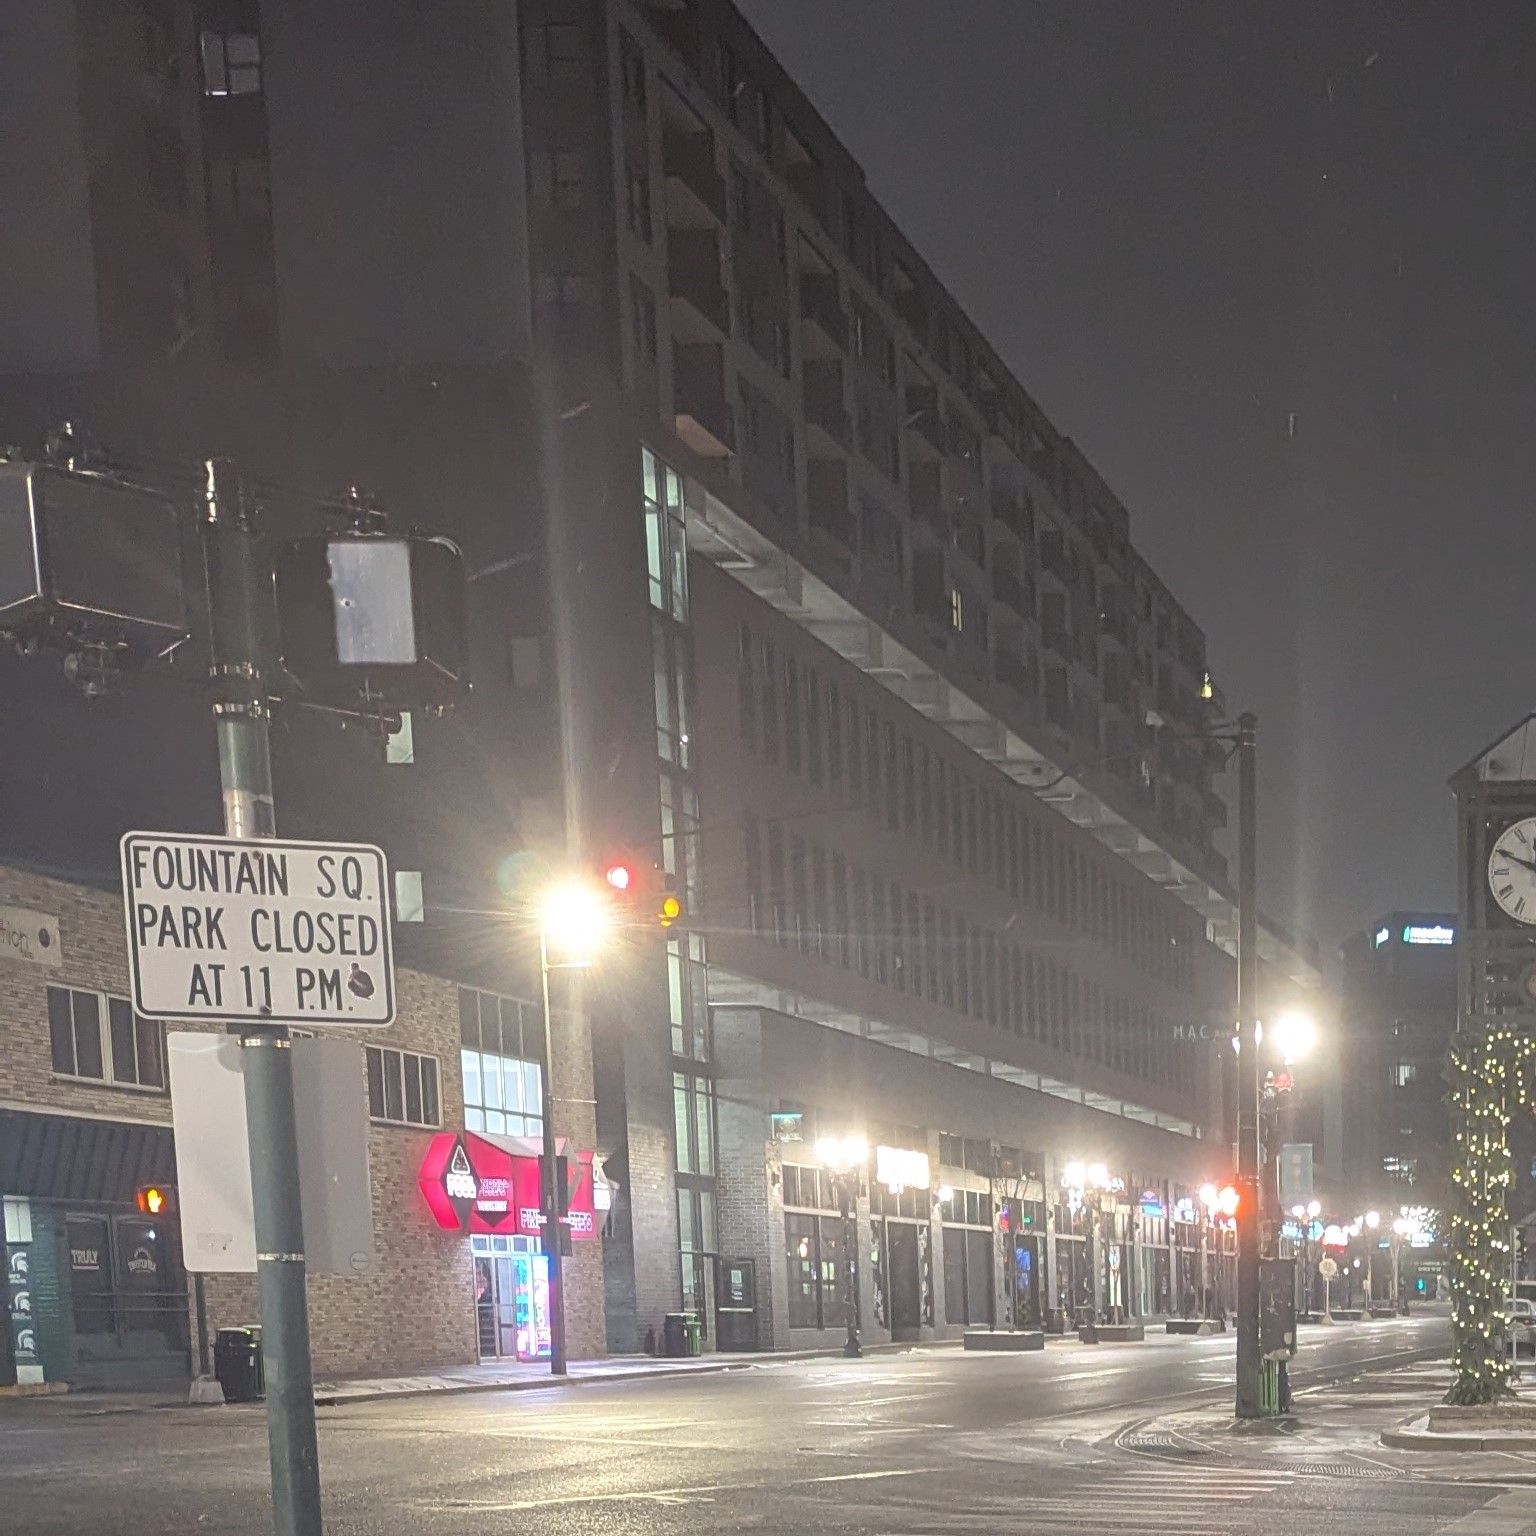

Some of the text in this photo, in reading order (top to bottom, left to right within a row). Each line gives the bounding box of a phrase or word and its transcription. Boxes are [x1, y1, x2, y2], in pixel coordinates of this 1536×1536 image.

[133, 846, 373, 901] FOUNTAIN SQ.
[137, 903, 378, 956] PARK CLOSED
[187, 963, 226, 1007] AT
[239, 965, 273, 1012] 11
[1173, 1025, 1208, 1040] MAC
[71, 1249, 98, 1264] TRULY
